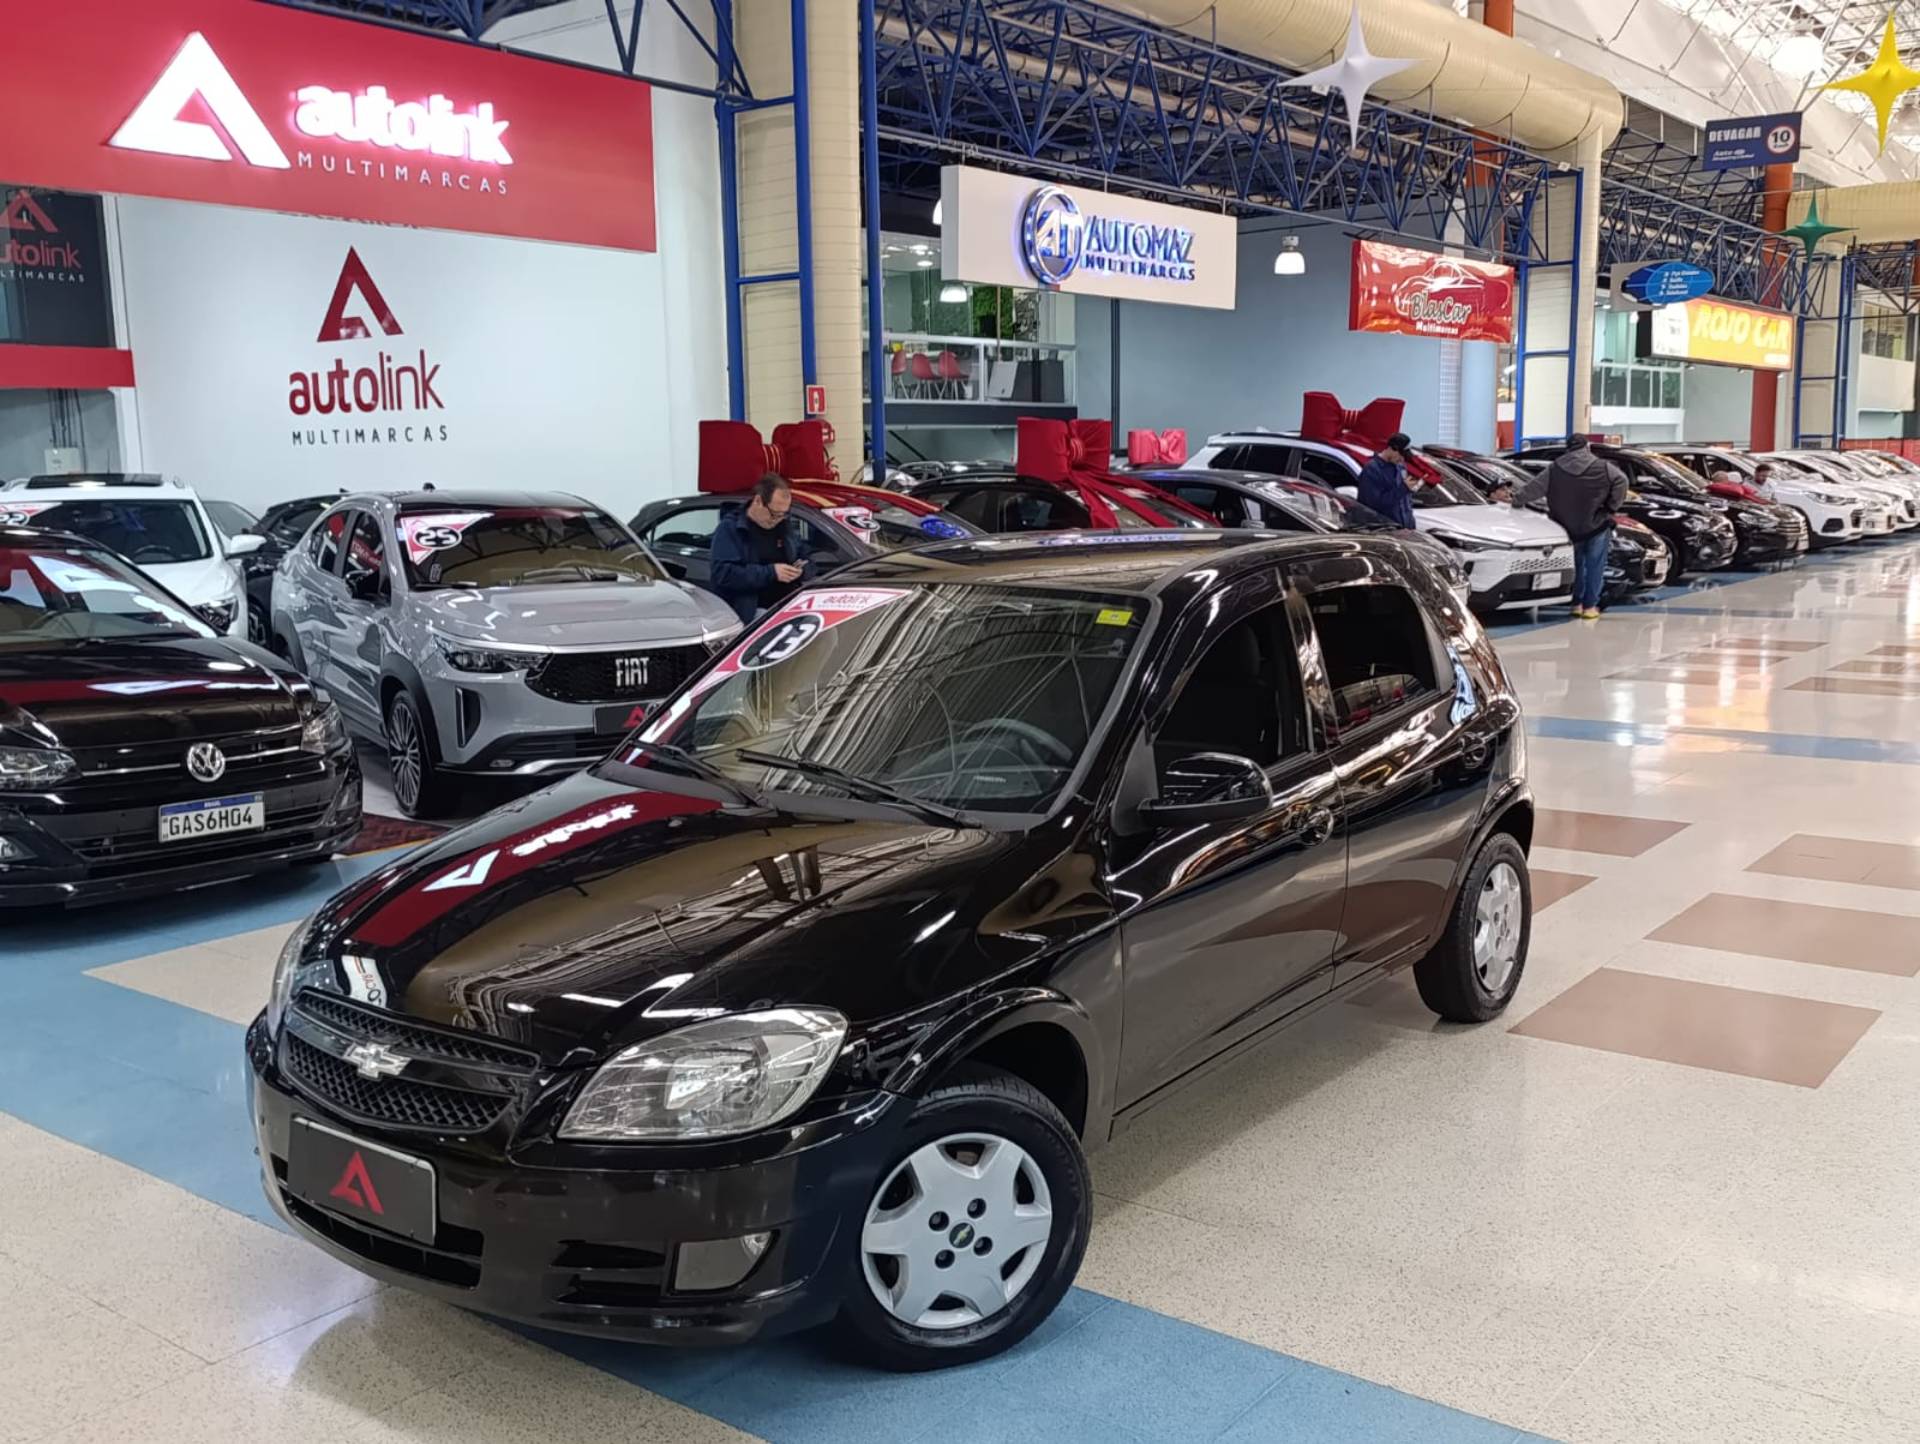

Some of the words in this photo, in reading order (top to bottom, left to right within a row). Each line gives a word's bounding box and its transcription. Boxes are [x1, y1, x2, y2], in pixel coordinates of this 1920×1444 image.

[294, 84, 514, 166] autolink
[1708, 126, 1762, 143] DEVAGAR
[1771, 130, 1791, 143] 10
[297, 150, 508, 195] MULTIMARCAS
[1085, 214, 1197, 265] AUTOMAZ
[1084, 253, 1196, 281] MULTIMARCAS
[1410, 289, 1473, 325] BlasCar
[1754, 315, 1790, 351] CAR
[288, 348, 446, 417] autolink
[291, 424, 449, 446] MULTIMARCAS
[418, 528, 458, 546] 25
[758, 623, 817, 659] 13
[615, 656, 650, 688] FIAT
